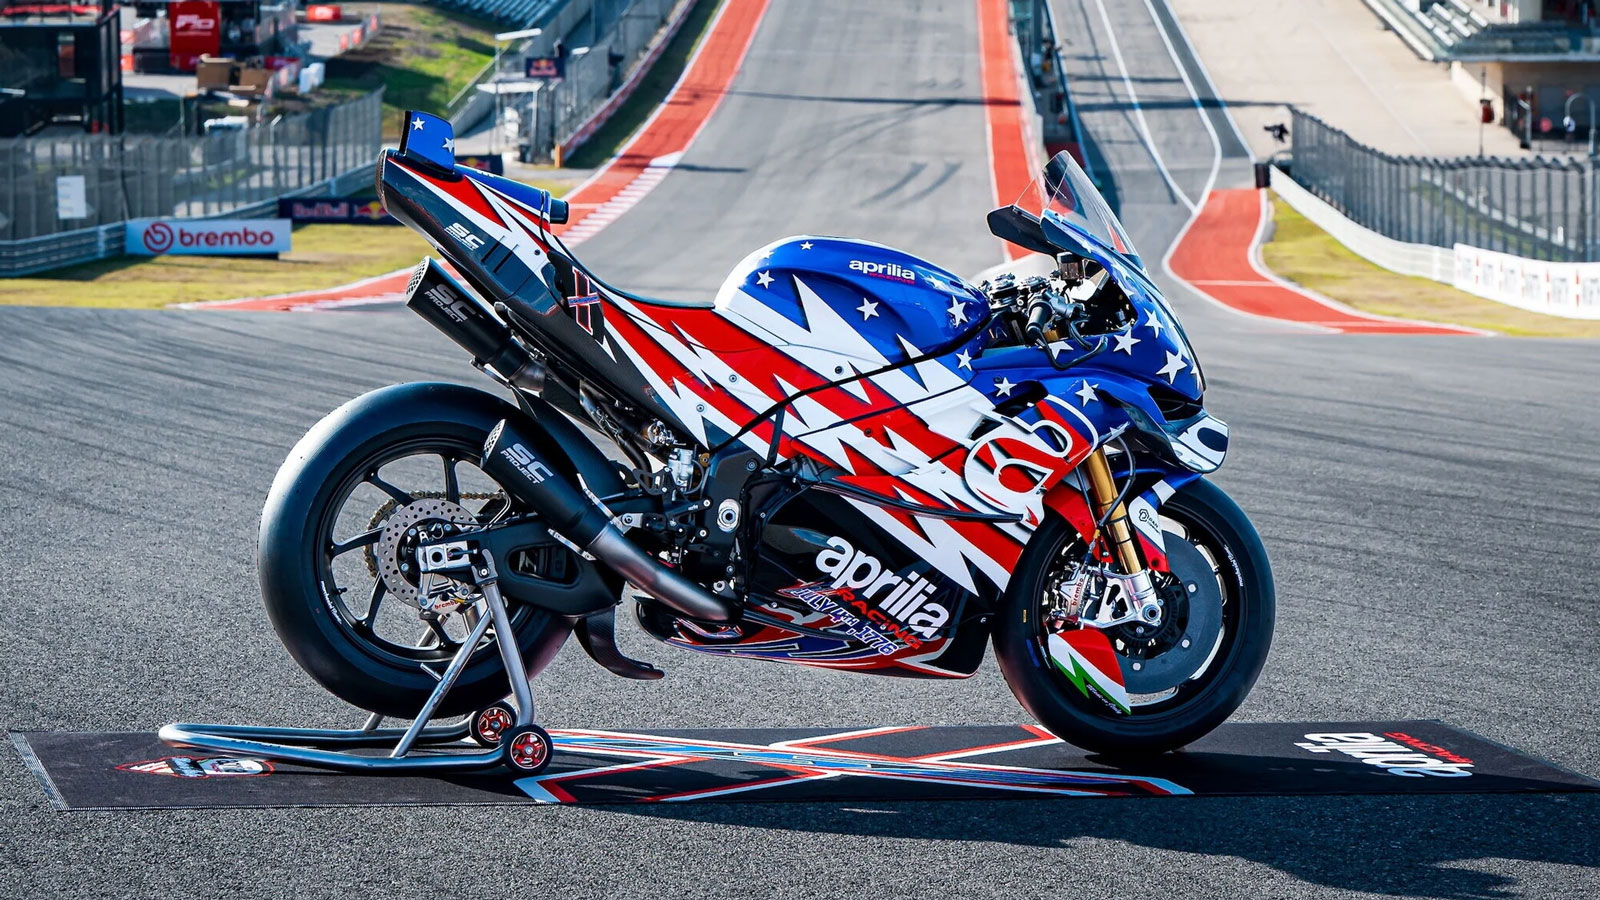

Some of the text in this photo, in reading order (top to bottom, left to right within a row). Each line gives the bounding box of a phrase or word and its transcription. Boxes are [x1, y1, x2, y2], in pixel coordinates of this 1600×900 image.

[179, 227, 274, 247] brembo
[848, 259, 916, 281] aprilia
[423, 290, 464, 323] PROJECT
[500, 449, 541, 484] PROJECT
[815, 535, 950, 639] aprilia
[1070, 577, 1085, 607] brembo
[789, 587, 839, 613] JULY
[852, 624, 900, 656] 1776
